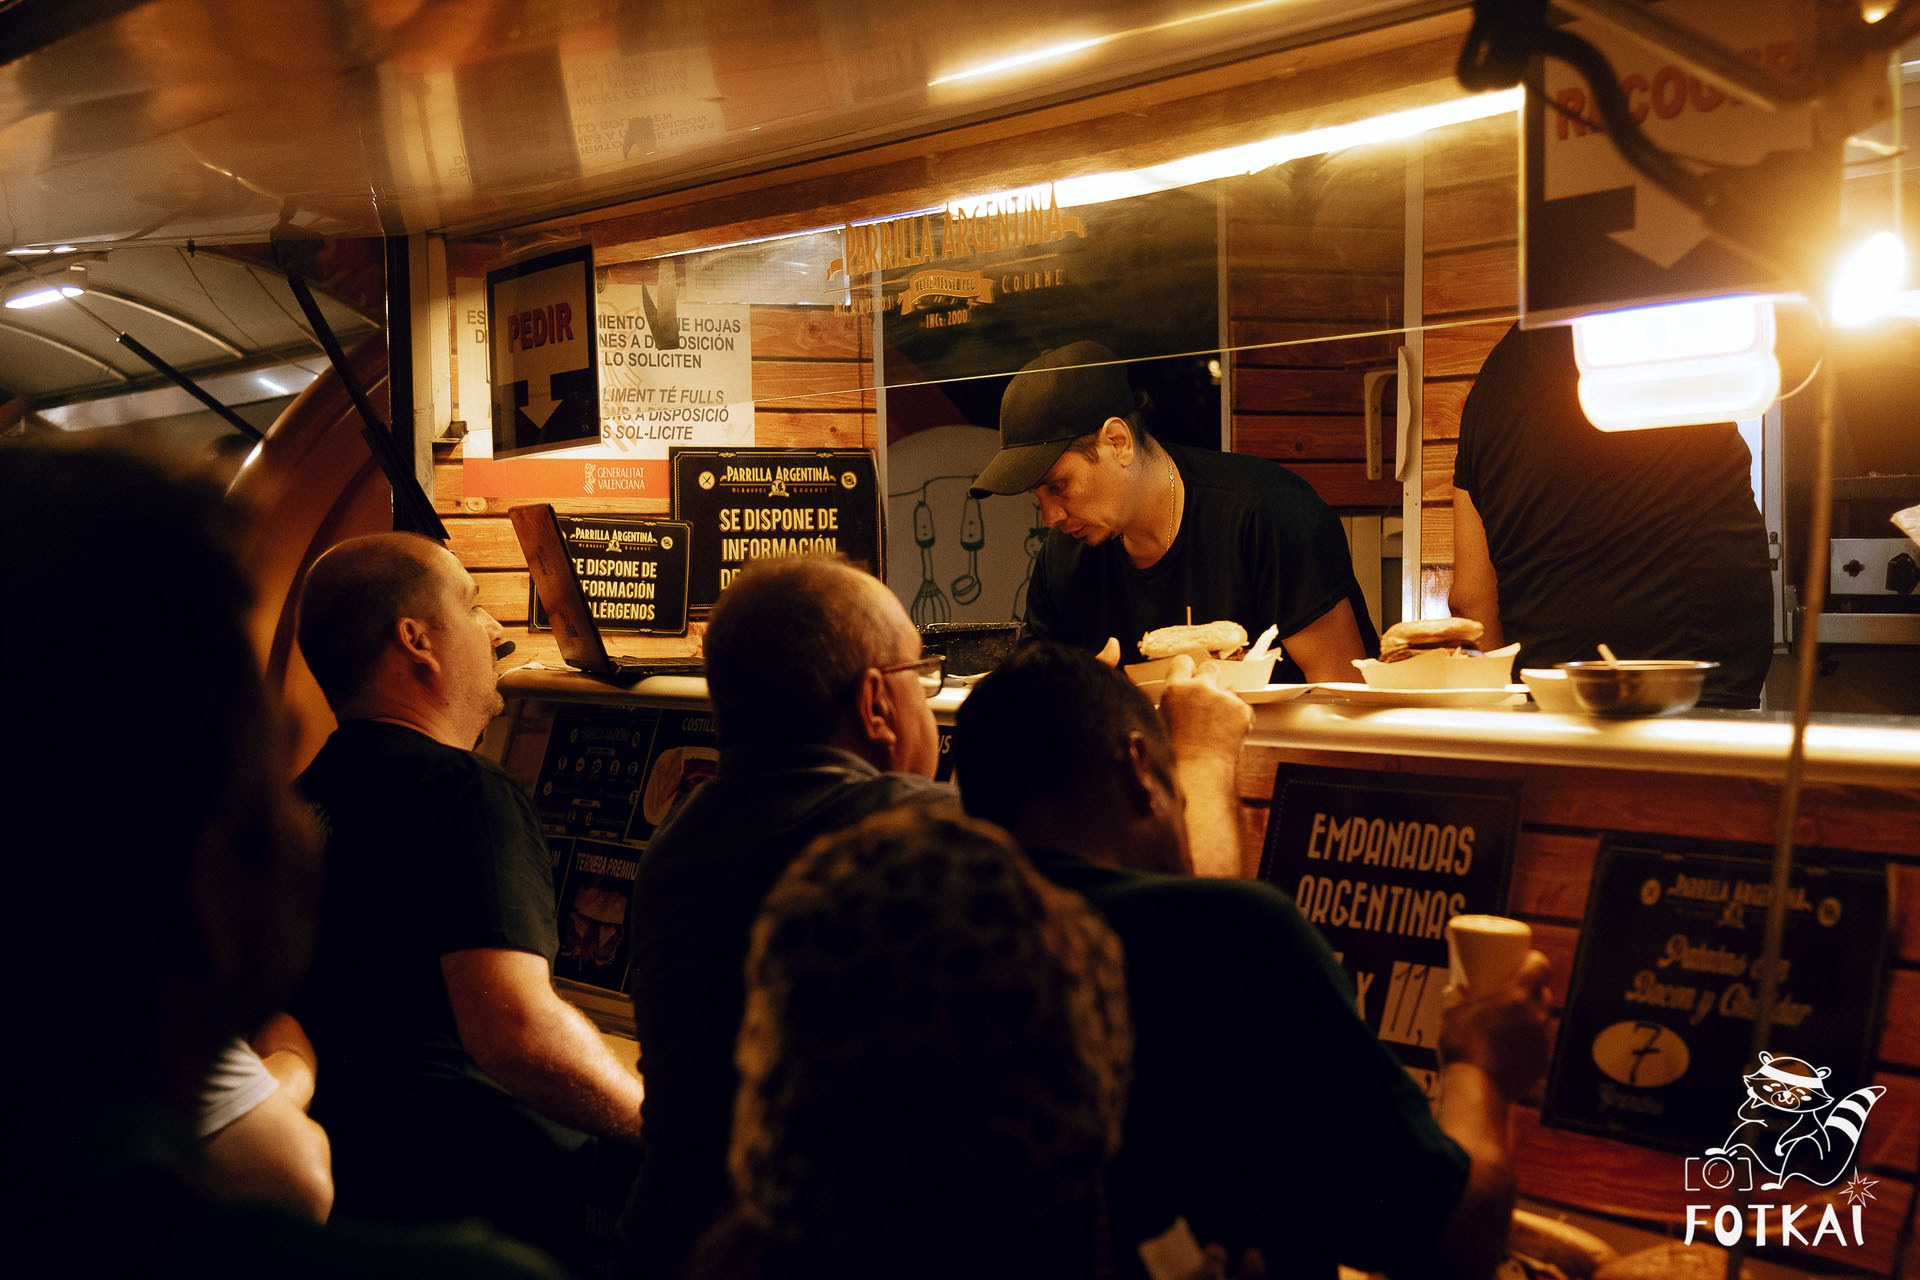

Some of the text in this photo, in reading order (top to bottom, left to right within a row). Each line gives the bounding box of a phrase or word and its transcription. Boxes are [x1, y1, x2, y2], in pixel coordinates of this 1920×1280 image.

[845, 182, 1065, 276] PARRILLA ARGENTINA
[507, 302, 574, 354] PEDIR
[694, 318, 741, 333] HOJAS
[630, 335, 641, 348] A
[605, 352, 702, 369] LO SOLICITEN
[659, 386, 676, 403] TÉ
[680, 388, 724, 404] FULLS
[649, 405, 729, 422] DISPOSICIÓ
[597, 467, 645, 478] GENERALITAT
[727, 465, 830, 482] PARRILLA ARGENTINA
[597, 479, 646, 490] VALENCIANA
[719, 508, 839, 532] SE DISPONE DE
[575, 527, 653, 544] PARRILLA ARGENTINA
[721, 534, 837, 562] INFORMACIÓN
[586, 559, 640, 578] DISPONE
[641, 561, 658, 579] DE
[1307, 812, 1476, 876] EMPANADAS
[1296, 874, 1466, 940] ARGENTINAS
[1631, 1020, 1661, 1085] 7
